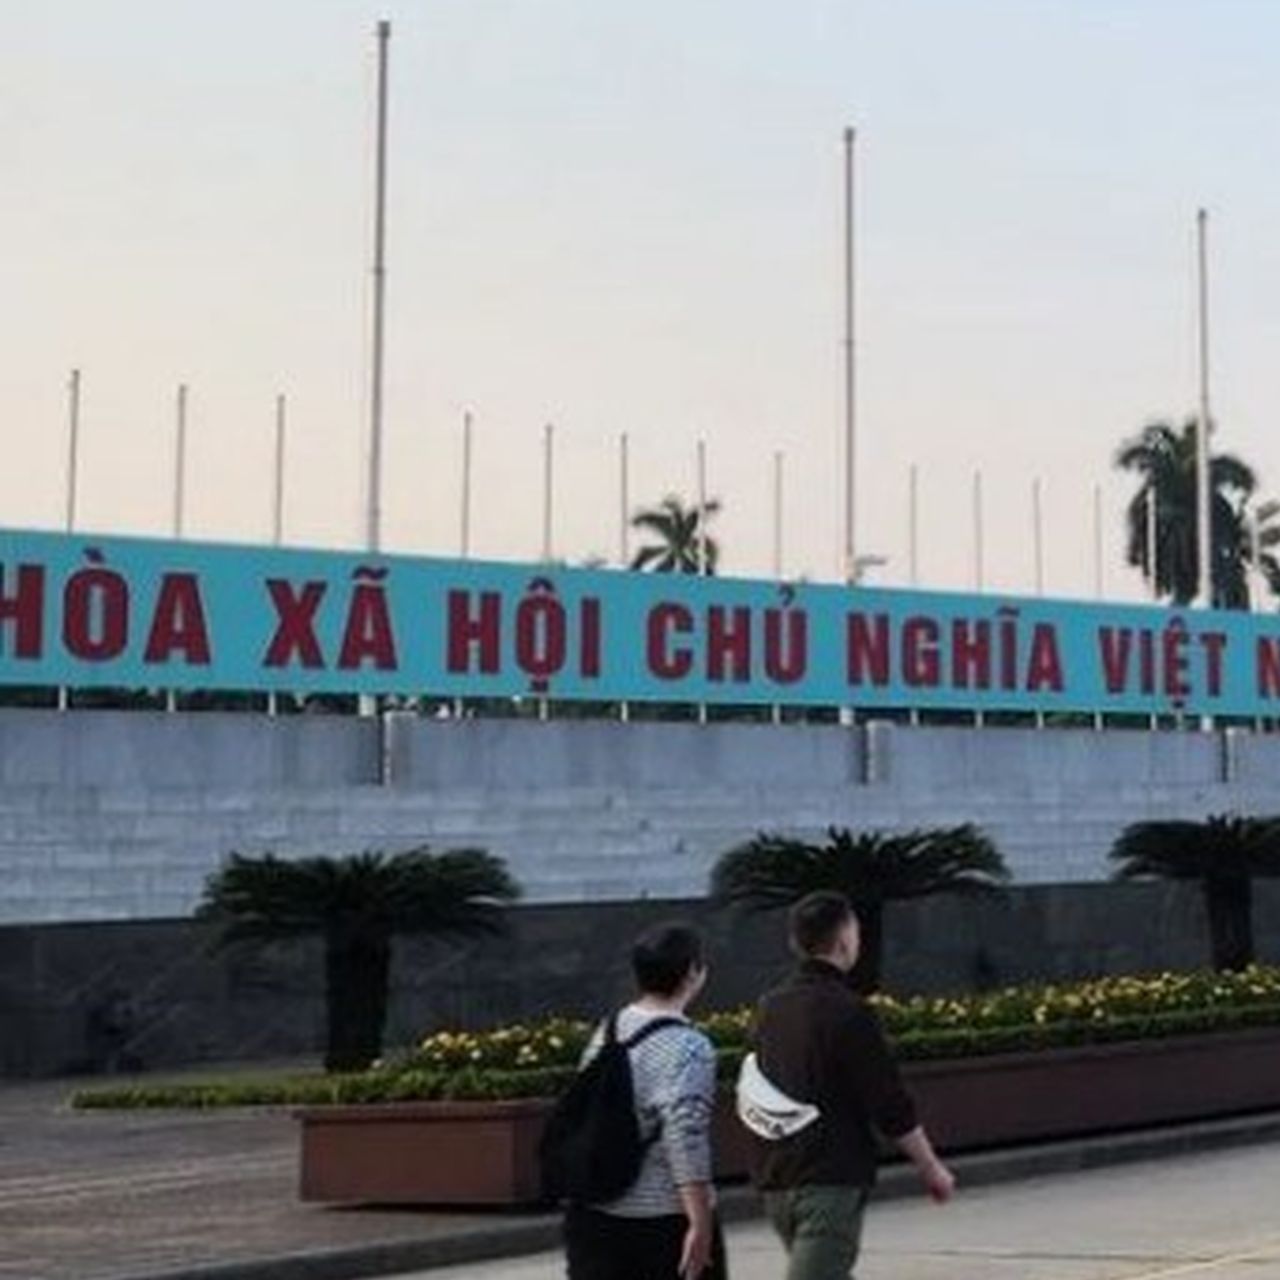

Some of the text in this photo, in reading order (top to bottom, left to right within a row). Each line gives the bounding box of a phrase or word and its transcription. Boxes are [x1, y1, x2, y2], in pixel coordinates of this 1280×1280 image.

[0, 547, 211, 664] HÒA
[262, 566, 398, 669] XÃ
[446, 576, 600, 692] HỘI
[646, 584, 808, 683] CHỦ
[847, 607, 1065, 692] NGHĨA
[1098, 615, 1226, 708] VIỆT
